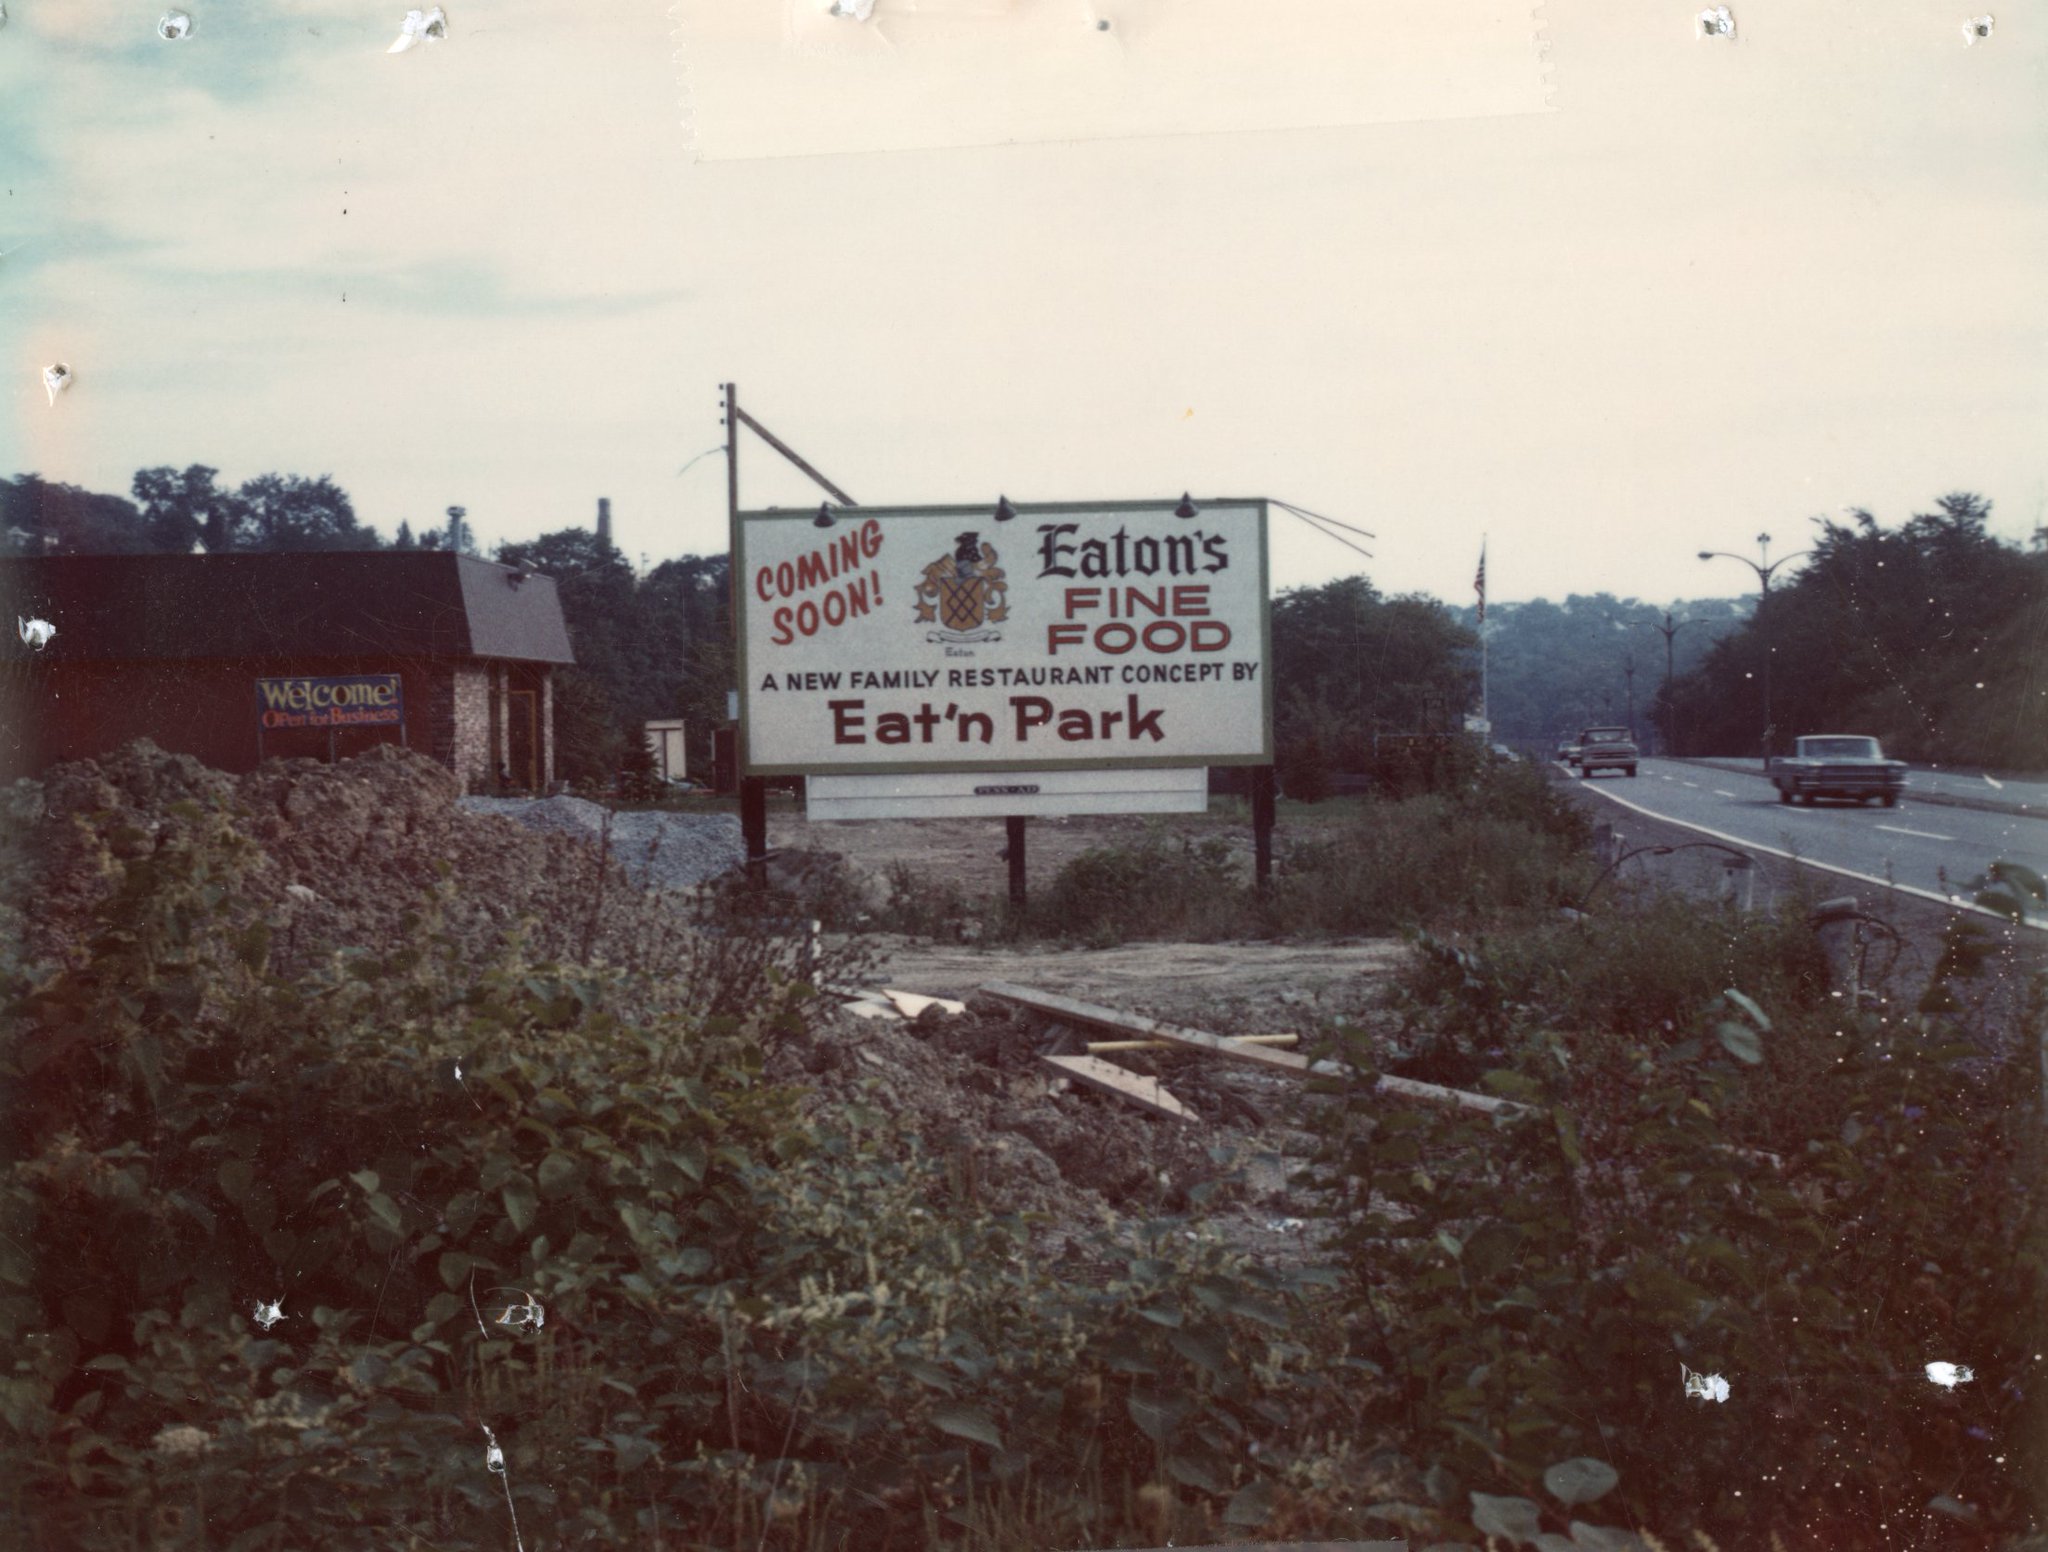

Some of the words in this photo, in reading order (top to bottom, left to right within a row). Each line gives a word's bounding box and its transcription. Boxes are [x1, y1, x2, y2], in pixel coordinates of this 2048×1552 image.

[757, 518, 884, 602] COMING
[1036, 523, 1229, 580] Eaton's
[770, 569, 884, 646] SOON!
[1065, 585, 1210, 619] FINE
[1048, 620, 1231, 656] FOOD
[261, 679, 399, 710] Welcome!
[760, 673, 779, 691] A
[786, 671, 842, 691] NEW
[850, 669, 940, 690] FAMILY
[948, 666, 1115, 687] RESTAURANT
[1121, 662, 1225, 685] CONCEPT
[1232, 662, 1259, 681] BY
[828, 699, 994, 745] Eat'n
[1009, 694, 1165, 743] Park
